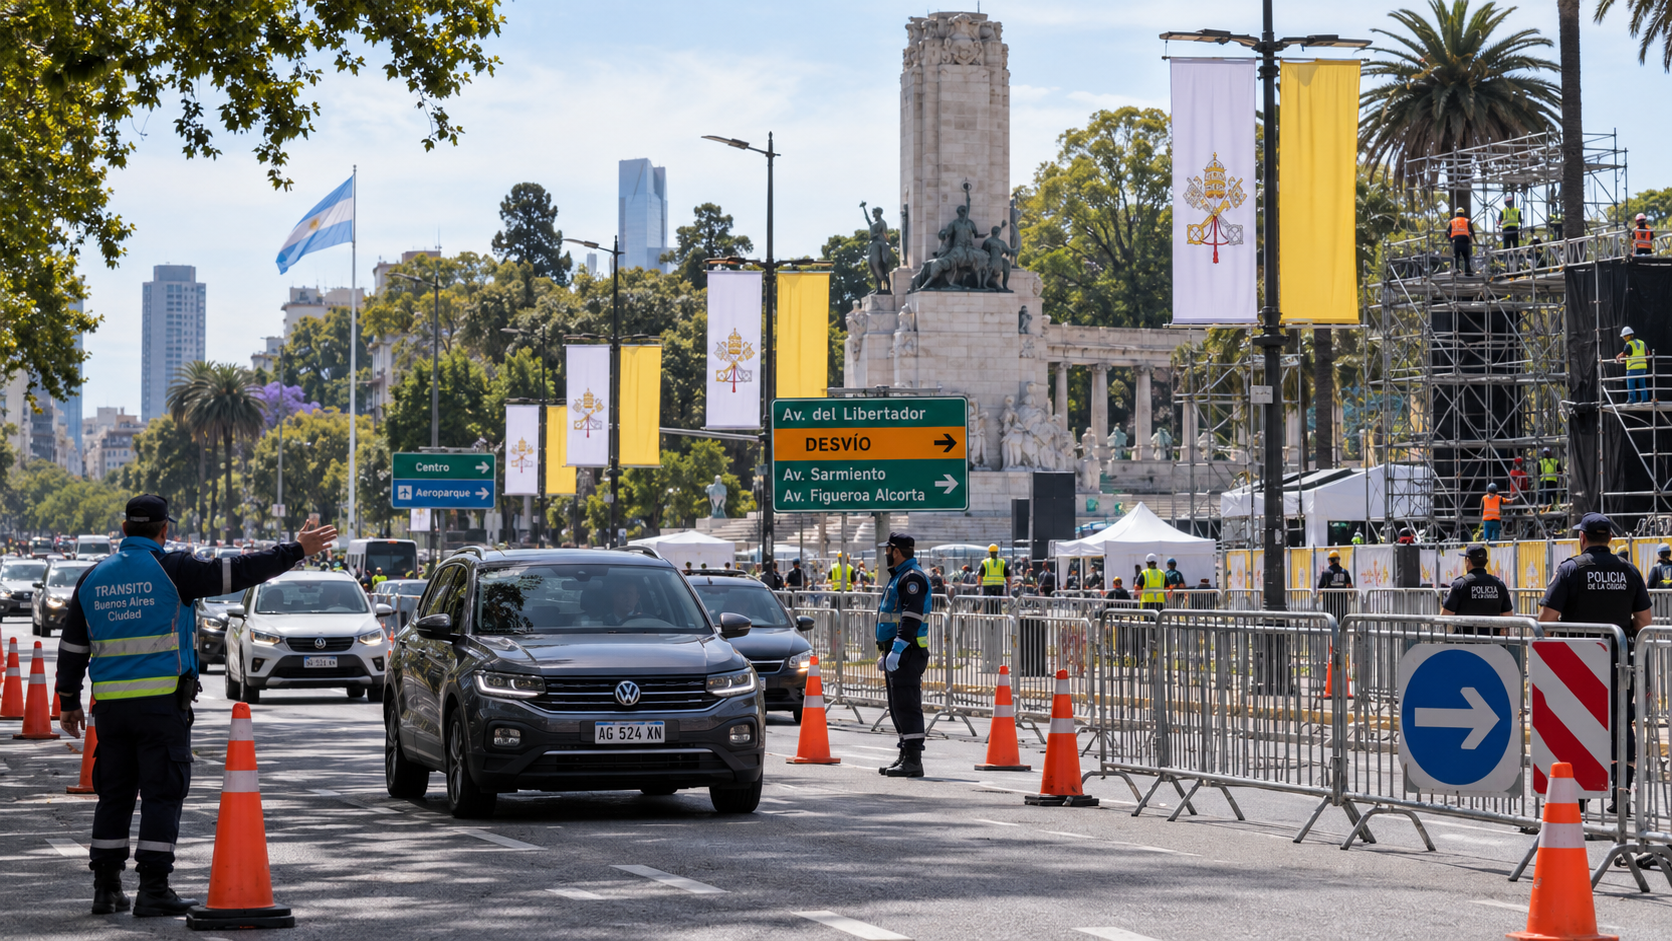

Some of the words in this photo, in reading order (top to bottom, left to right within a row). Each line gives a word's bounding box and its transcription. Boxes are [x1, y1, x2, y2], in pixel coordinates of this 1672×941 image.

[782, 408, 806, 421] Av.
[812, 407, 837, 421] del
[843, 407, 926, 421] Libertador
[805, 433, 871, 451] DESVÍO
[415, 462, 449, 472] Centro
[783, 468, 805, 481] Av.
[810, 467, 886, 481] Sarmiento
[415, 488, 471, 499] Aeroparque
[783, 489, 805, 502] Av.
[810, 488, 870, 505] Figueroa
[875, 488, 925, 501] Alcorta
[1587, 571, 1627, 583] POLICIA
[95, 582, 152, 597] TRANSITO
[94, 600, 127, 610] Buenos
[129, 596, 155, 606] Aires
[599, 727, 613, 739] AG
[619, 726, 641, 739] 524
[647, 726, 661, 739] XN
